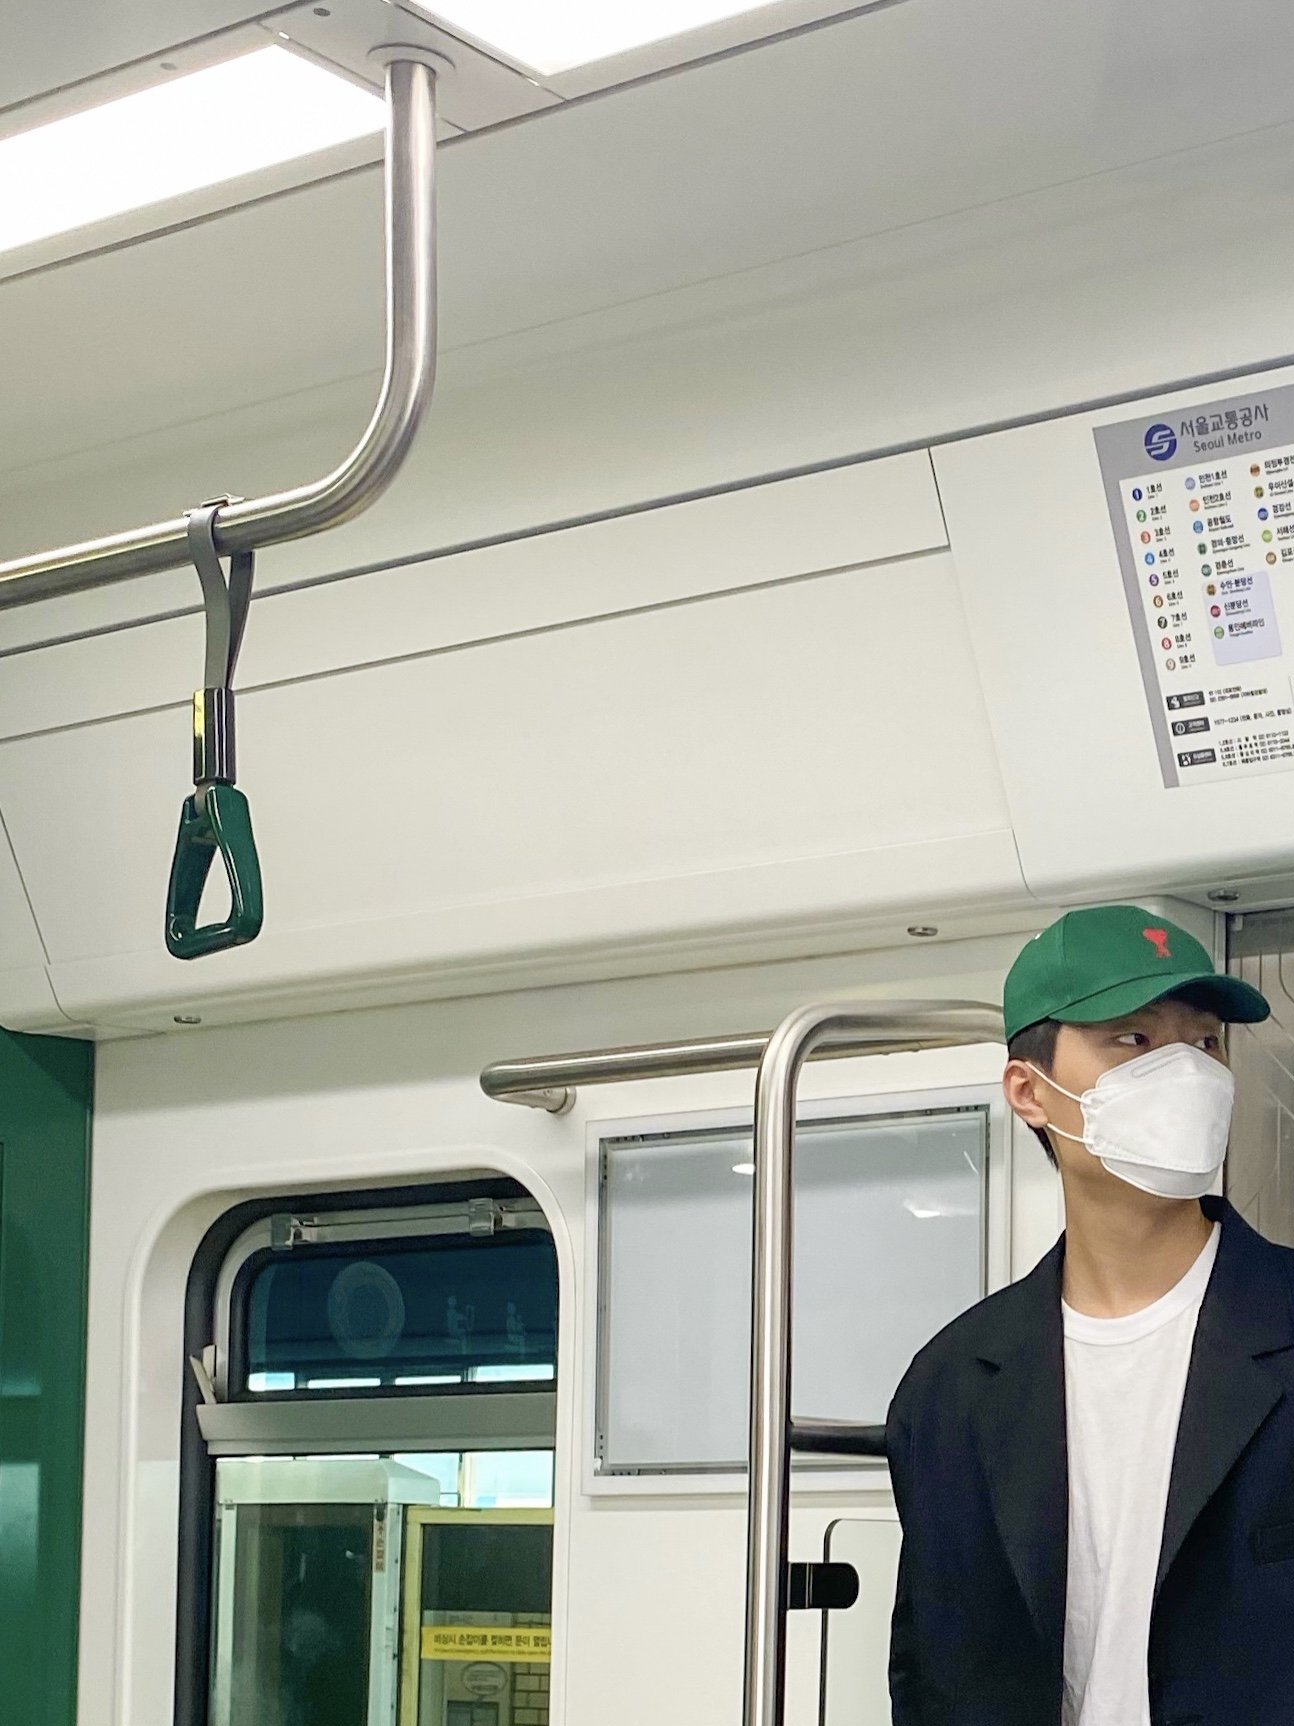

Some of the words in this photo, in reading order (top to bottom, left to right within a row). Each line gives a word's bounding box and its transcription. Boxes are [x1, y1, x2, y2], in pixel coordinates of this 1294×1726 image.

[1180, 403, 1269, 438] 서울교통공사
[1193, 437, 1225, 453] Seoul
[1227, 429, 1262, 446] Metro
